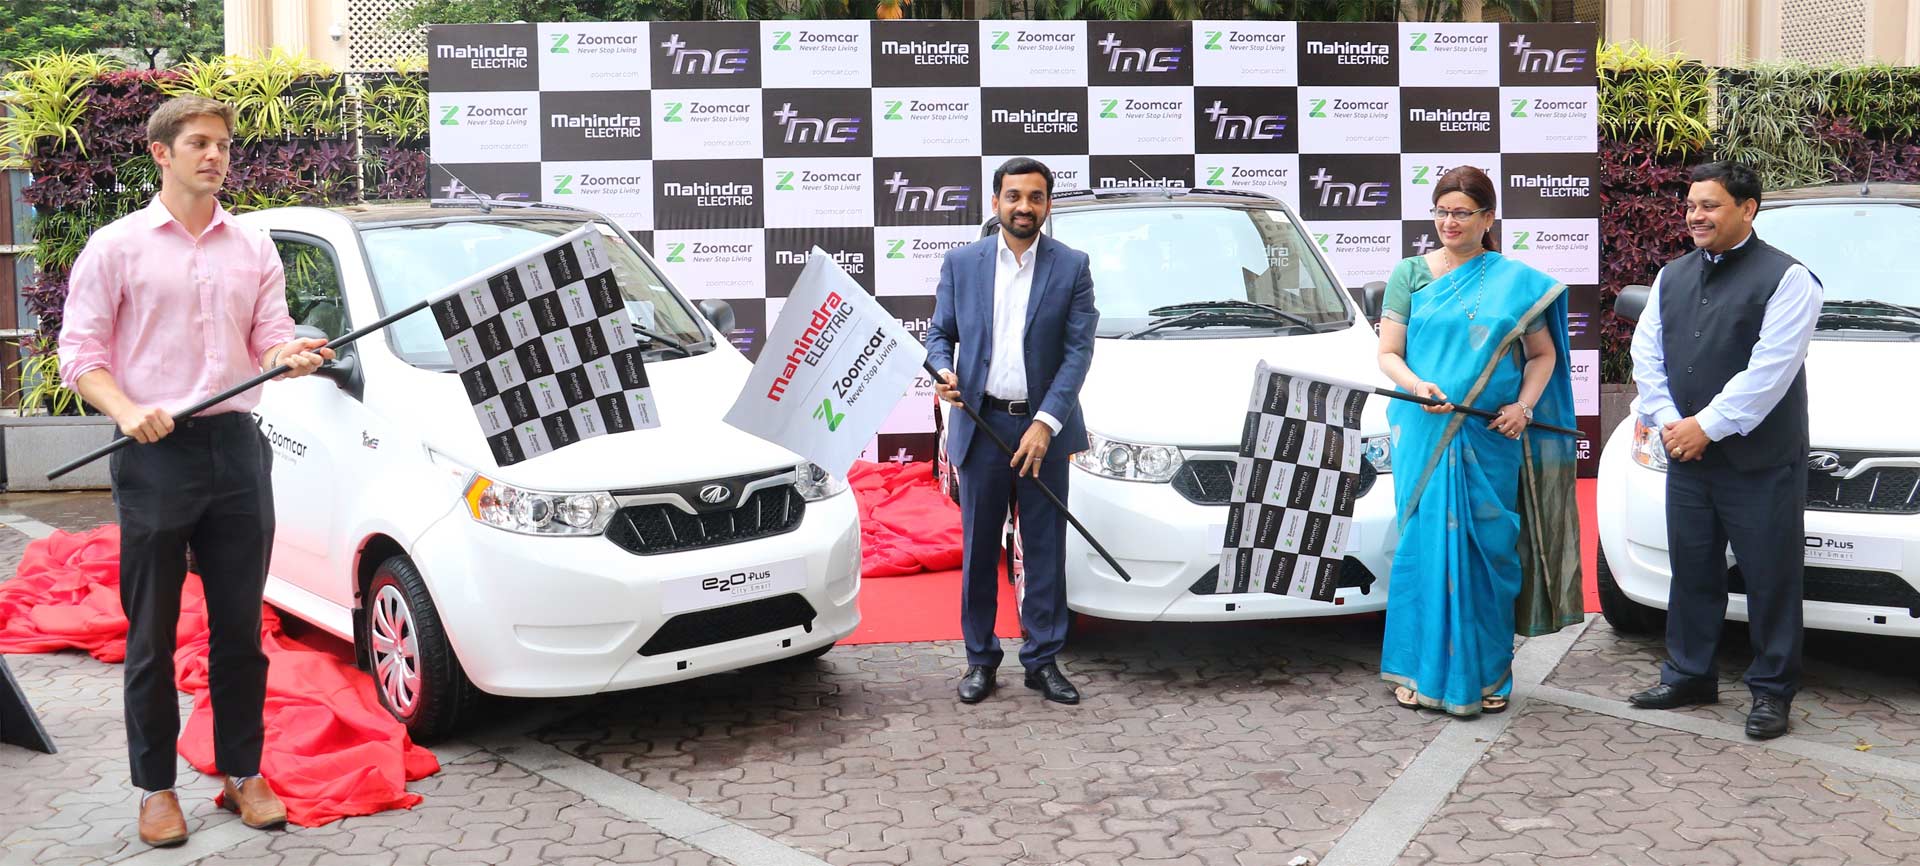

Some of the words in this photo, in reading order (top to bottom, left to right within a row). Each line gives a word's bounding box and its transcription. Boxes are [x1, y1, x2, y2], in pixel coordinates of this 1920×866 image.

[577, 34, 637, 44] Zoomcar
[799, 32, 858, 42] Zoomcar
[1017, 31, 1075, 42] Zoomcar
[1230, 32, 1285, 42] Zoomcar
[1434, 33, 1488, 43] Zoomcar
[438, 44, 527, 58] Mahindra
[882, 41, 968, 54] Mahindra
[1308, 42, 1388, 54] Mahindra
[472, 58, 527, 68] ELECTRIC
[915, 55, 968, 64] ELECTRIC
[1338, 55, 1388, 64] ELECTRIC
[690, 102, 750, 113] Zoomcar
[910, 101, 968, 111] Zoomcar
[1126, 100, 1182, 110] Zoomcar
[1334, 99, 1388, 110] Zoomcar
[1534, 99, 1587, 109] Zoomcar
[467, 106, 528, 116] Zoomcar
[992, 110, 1077, 122] Mahindra
[1410, 109, 1490, 121] Mahindra
[552, 114, 640, 127] Mahindra
[1024, 123, 1077, 132] ELECTRIC
[1440, 122, 1490, 131] ELECTRIC
[585, 128, 640, 138] ELECTRIC
[802, 171, 861, 182] Zoomcar
[1232, 167, 1288, 177] Zoomcar
[580, 174, 640, 185] Zoomcar
[1511, 175, 1589, 187] Mahindra
[664, 182, 752, 197] Mahindra
[1540, 188, 1589, 197] ELECTRIC
[698, 196, 752, 206] ELECTRIC
[1336, 234, 1391, 244] Zoomcar
[1536, 232, 1589, 241] Zoomcar
[693, 243, 752, 253] Zoomcar
[805, 302, 853, 367] ELECTRIC
[767, 292, 842, 402] Mahindra
[832, 327, 885, 399] Zoomcar
[847, 383, 864, 407] Never
[863, 365, 878, 384] Stop
[876, 339, 897, 365] Living
[267, 424, 307, 457] Zoomcar
